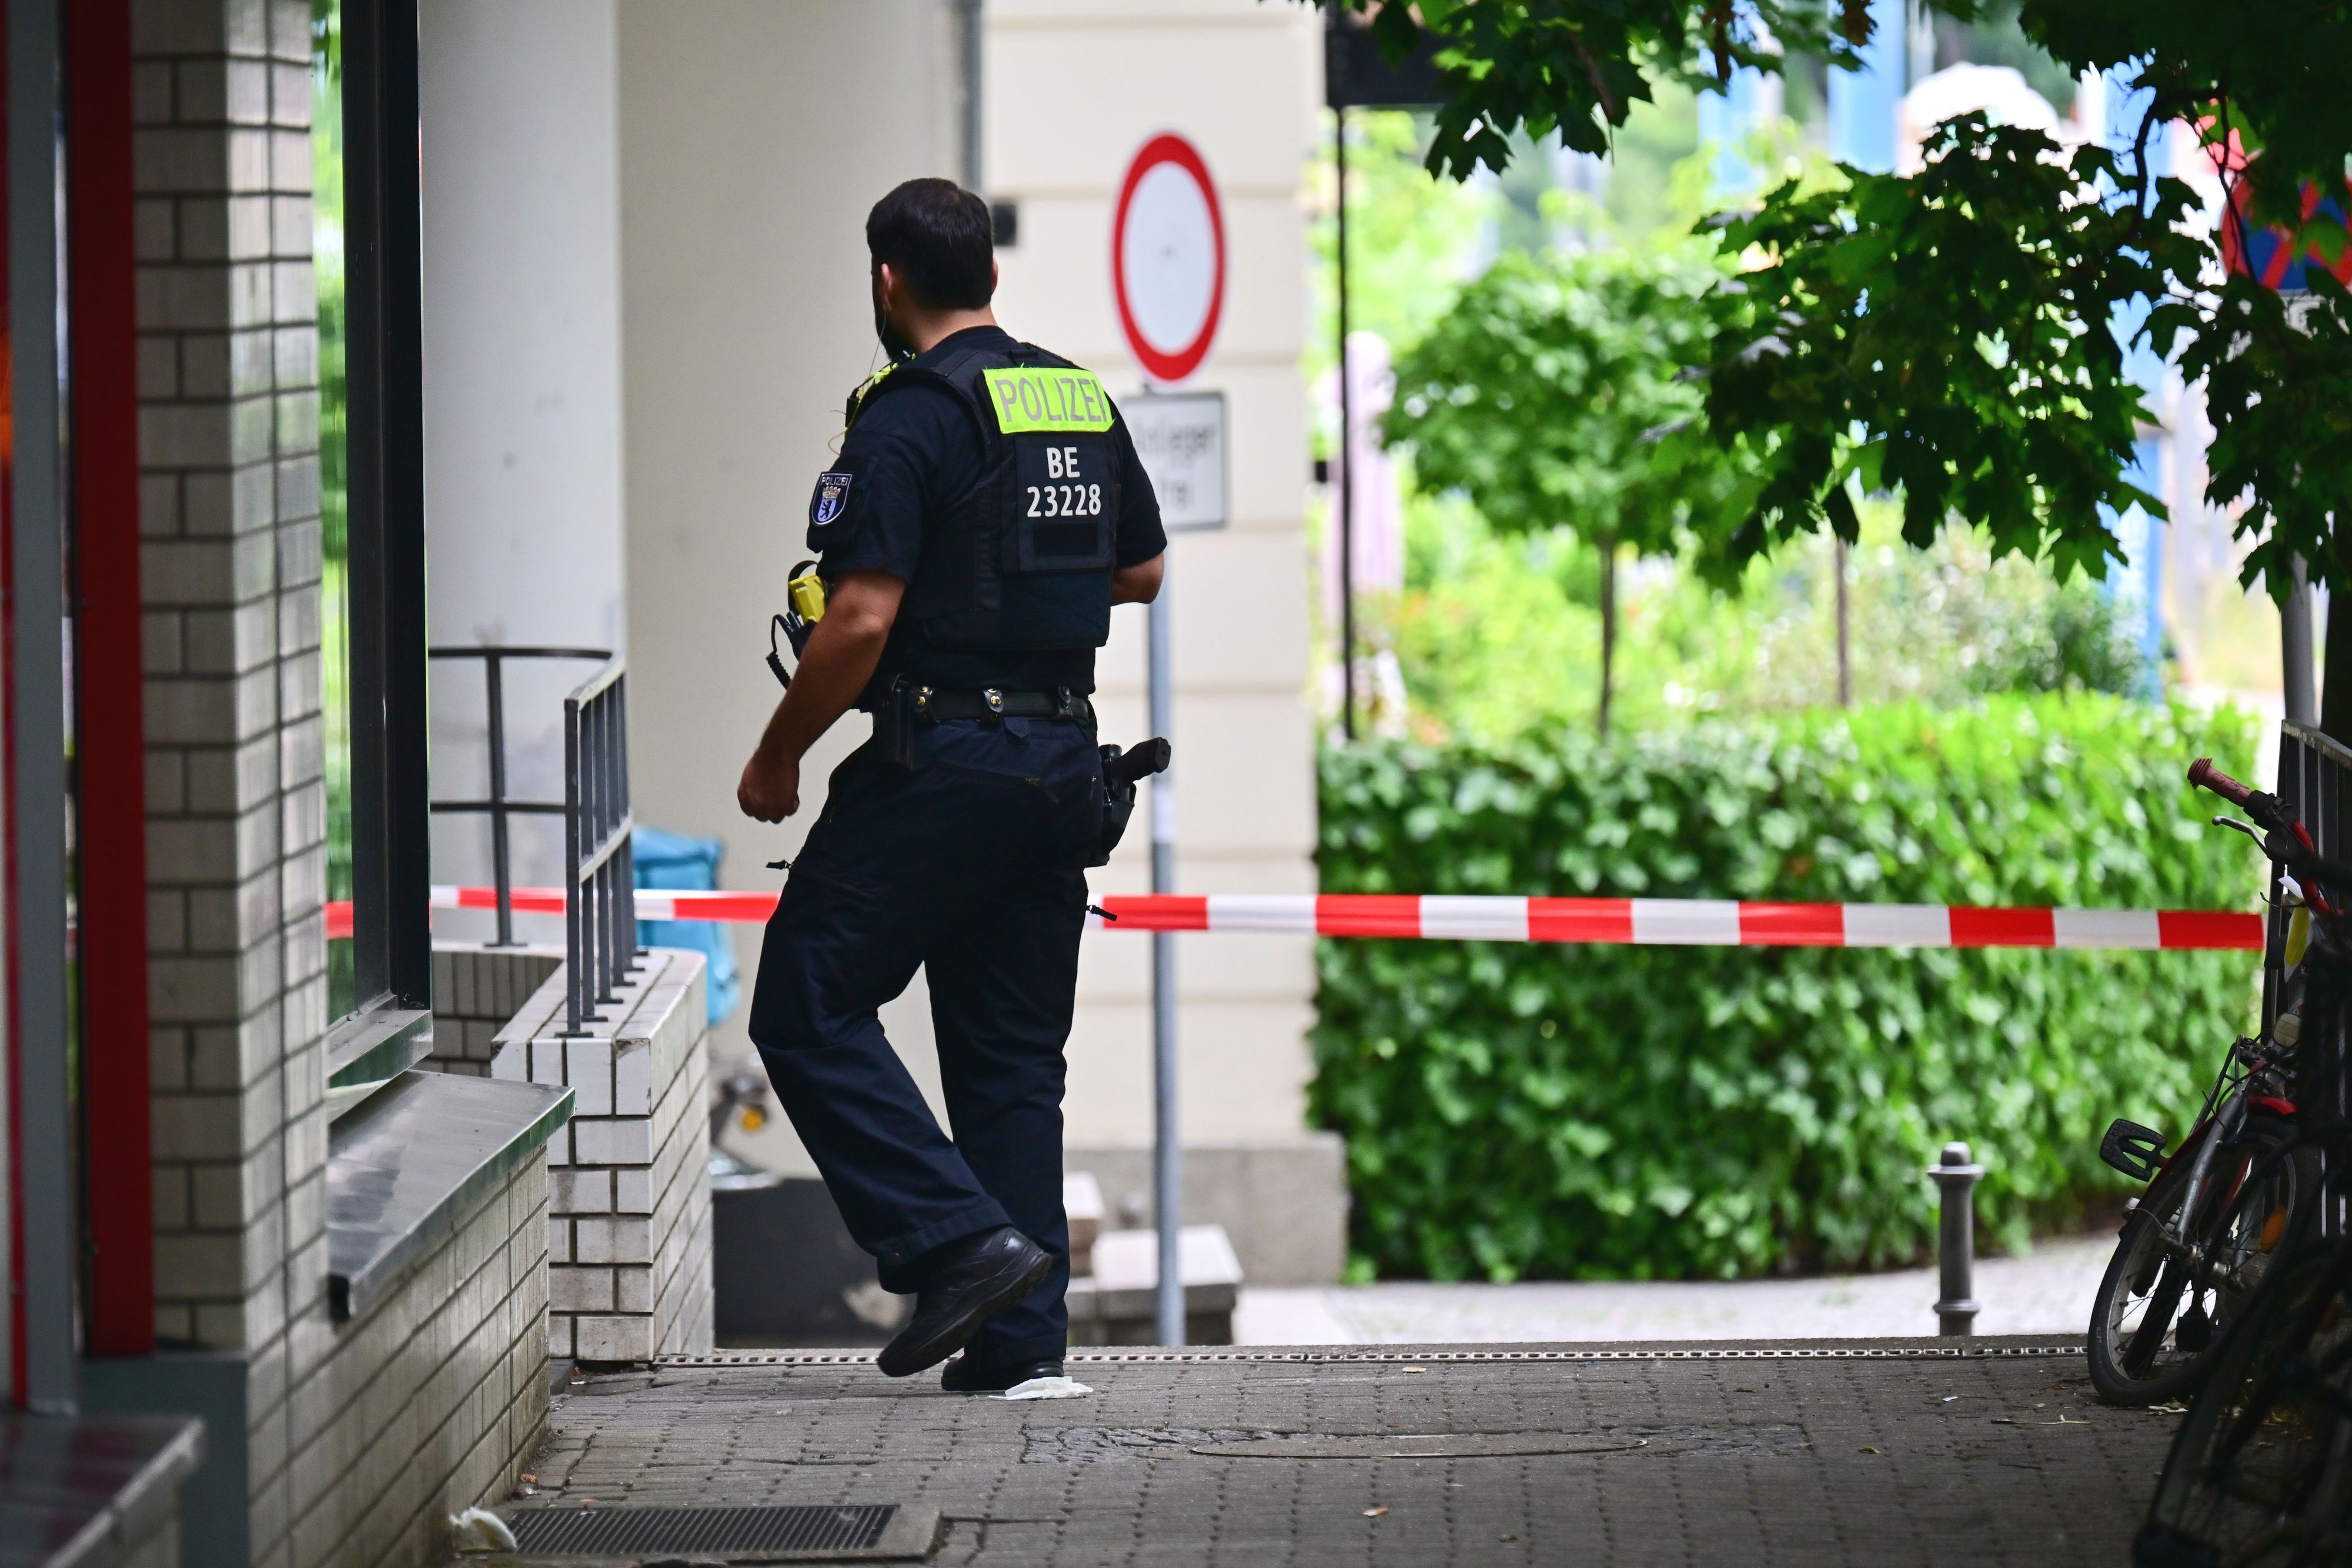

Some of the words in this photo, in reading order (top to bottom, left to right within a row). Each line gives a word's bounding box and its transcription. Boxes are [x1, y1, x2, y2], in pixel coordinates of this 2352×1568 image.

[994, 377, 1108, 423] POLIZEI
[1046, 446, 1081, 479] BE
[821, 476, 848, 486] POLIZEI
[1027, 483, 1101, 517] 23228
